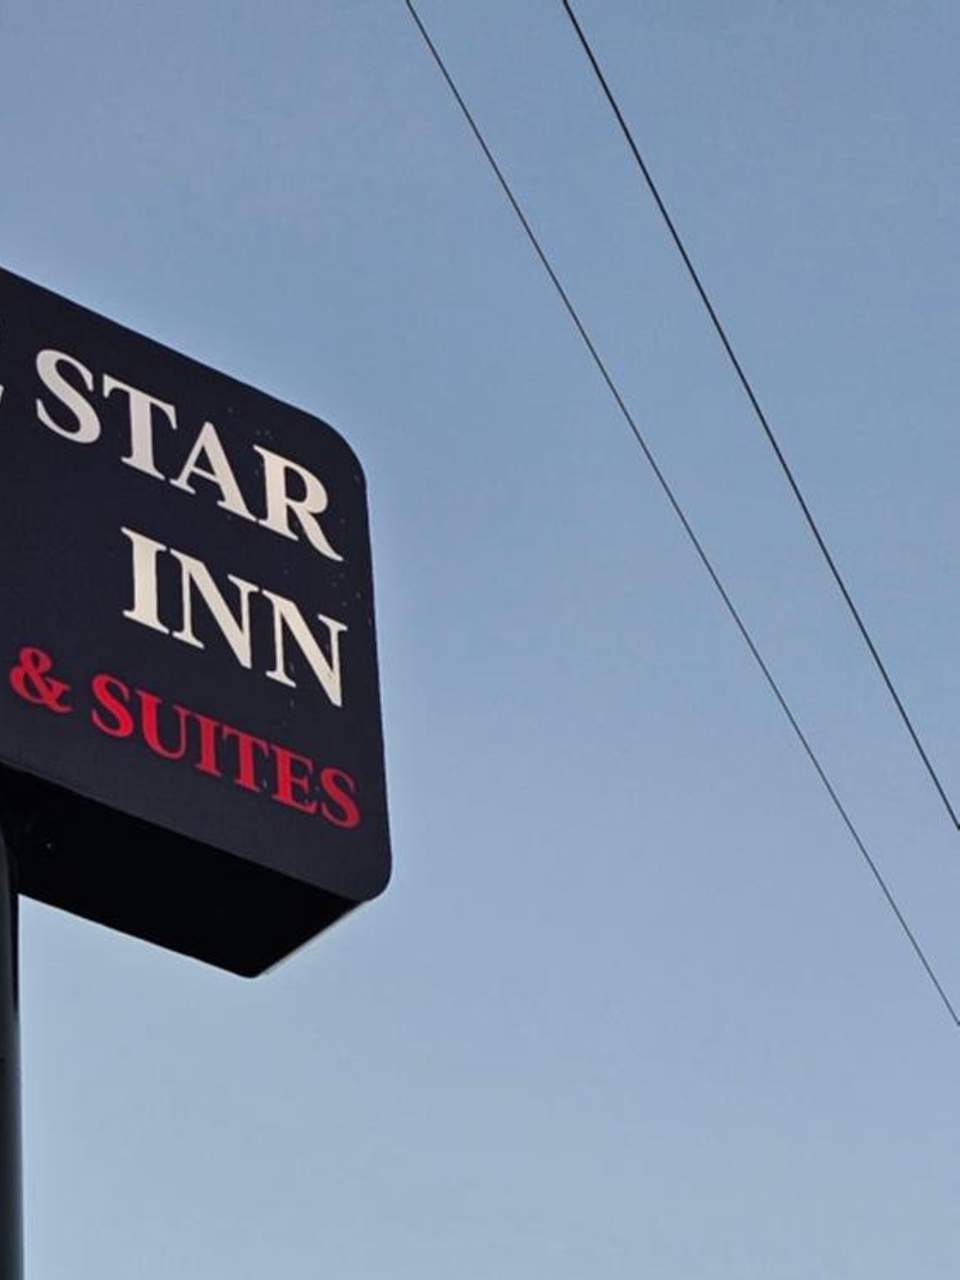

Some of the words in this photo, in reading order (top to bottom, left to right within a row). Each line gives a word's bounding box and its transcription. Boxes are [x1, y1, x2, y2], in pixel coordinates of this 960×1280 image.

[35, 348, 344, 563] STAR
[121, 526, 348, 708] INN
[9, 646, 71, 714] &
[91, 674, 360, 829] SUITES
